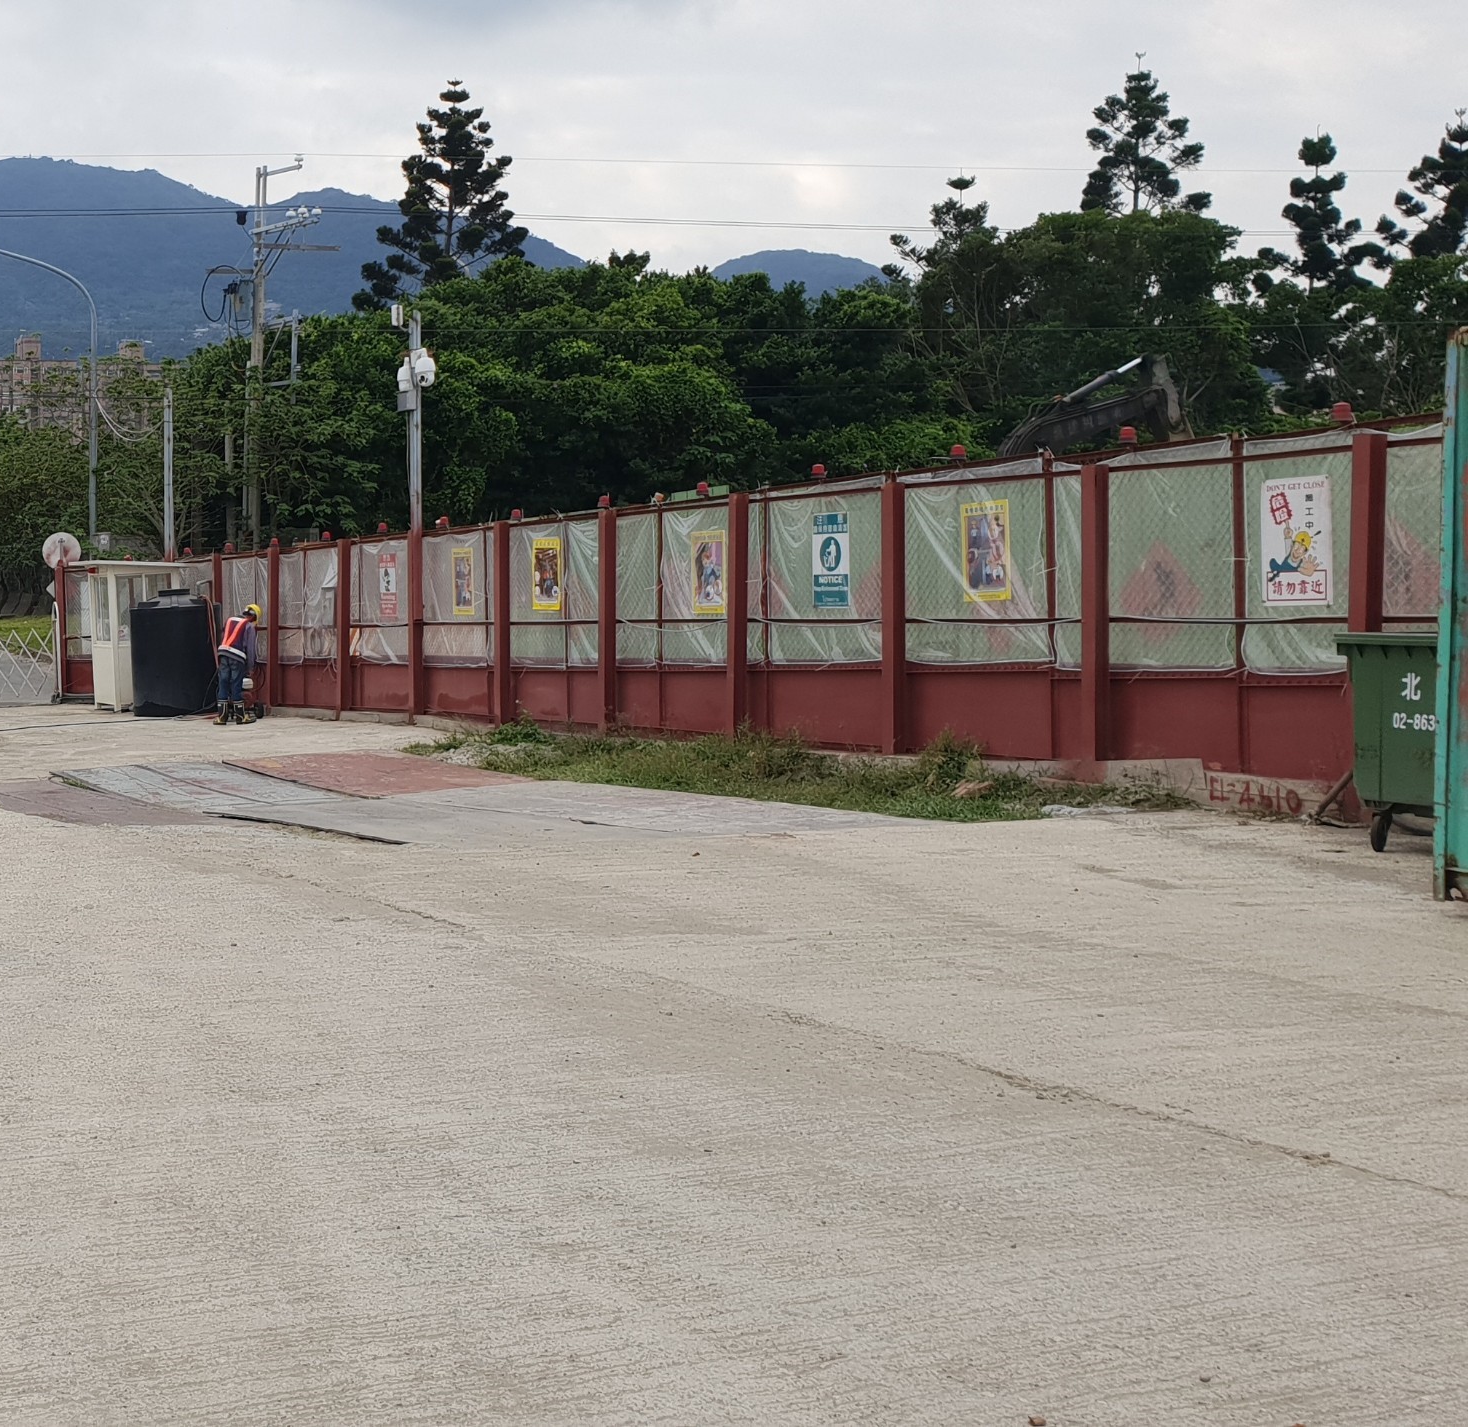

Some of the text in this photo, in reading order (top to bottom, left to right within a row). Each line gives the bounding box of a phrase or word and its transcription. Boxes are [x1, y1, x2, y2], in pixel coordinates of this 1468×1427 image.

[1266, 484, 1286, 492] DON'T
[1303, 481, 1325, 489] CLOSE
[818, 576, 843, 584] NOTICE
[1272, 579, 1324, 596] 請勿靠近
[1401, 672, 1421, 700] 北
